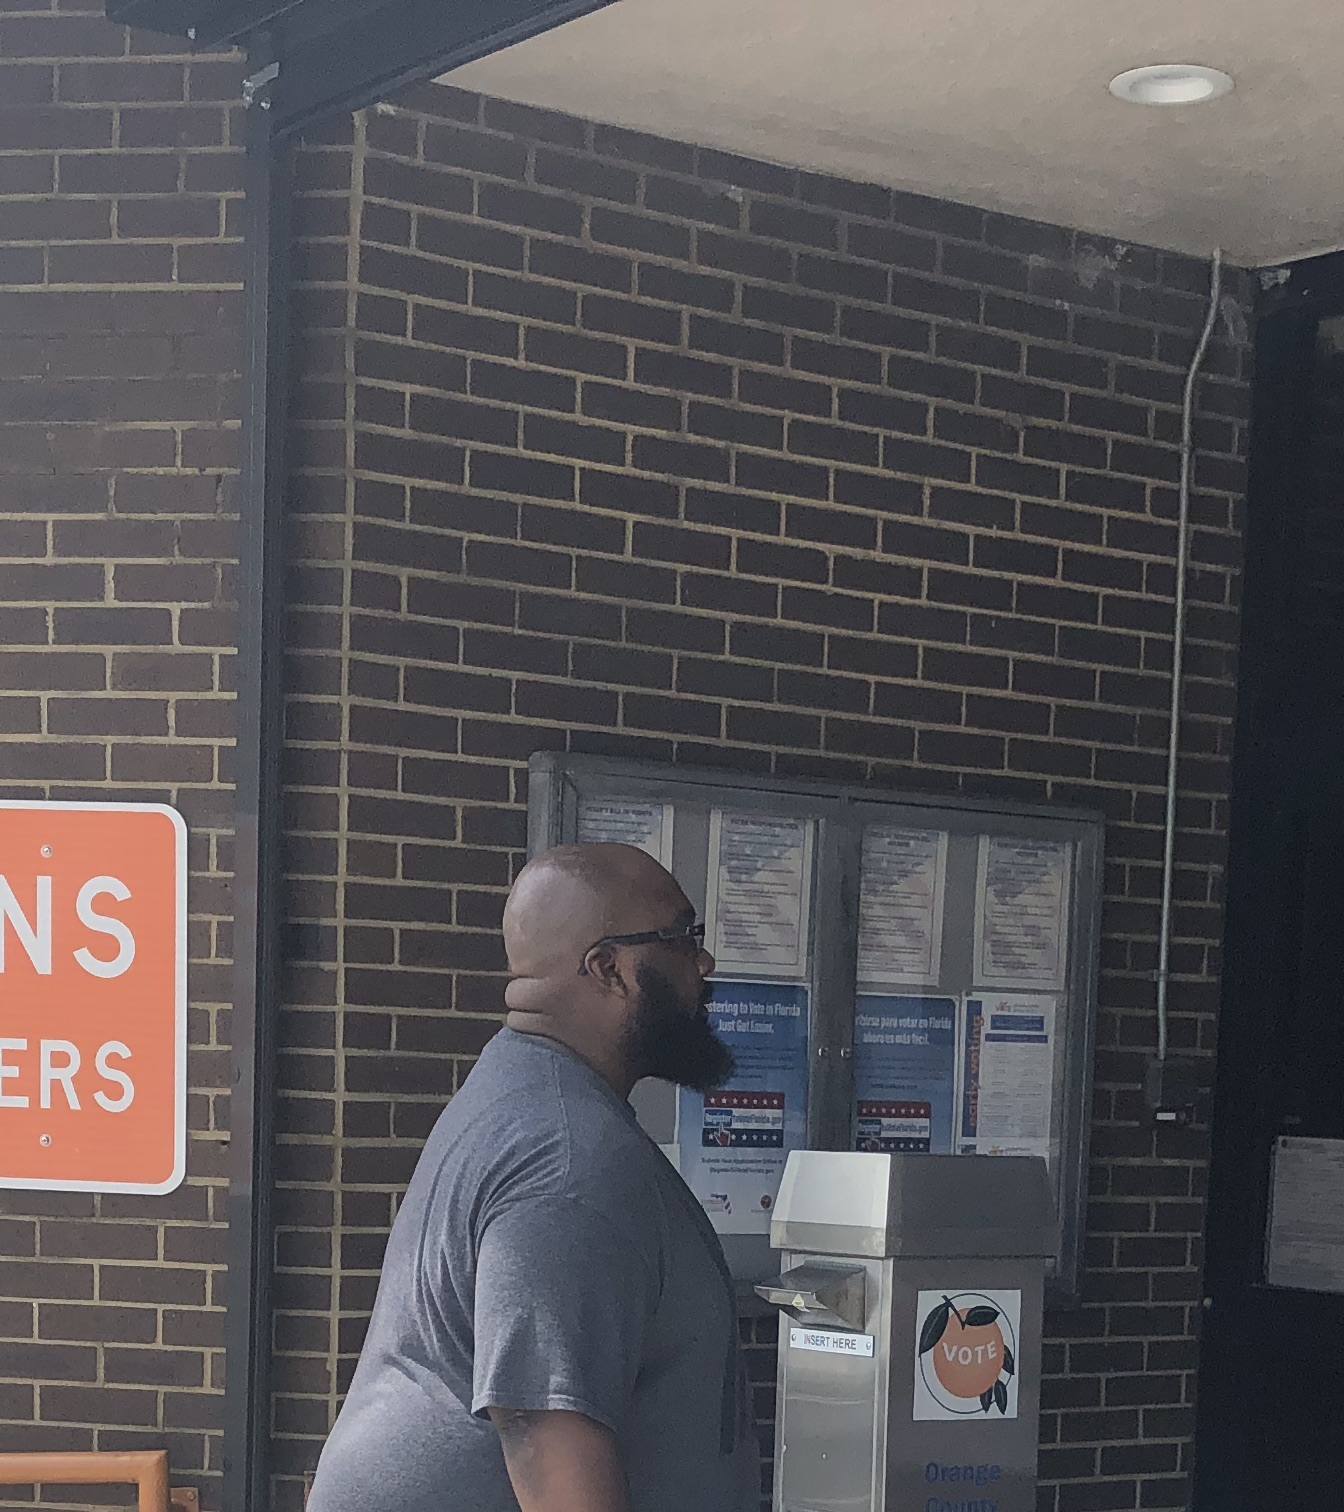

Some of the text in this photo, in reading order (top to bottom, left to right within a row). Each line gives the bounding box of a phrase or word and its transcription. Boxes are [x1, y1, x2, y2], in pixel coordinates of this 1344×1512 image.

[740, 1002, 749, 1014] to
[774, 1003, 801, 1017] Florida
[717, 1019, 736, 1032] Just
[737, 1019, 750, 1033] Got
[881, 1016, 898, 1029] para
[899, 1016, 917, 1028] votar
[929, 1016, 952, 1030] Florida
[803, 1333, 857, 1351] INSERT HERE
[943, 1340, 998, 1366] VOTE
[925, 1462, 1001, 1486] Orange
